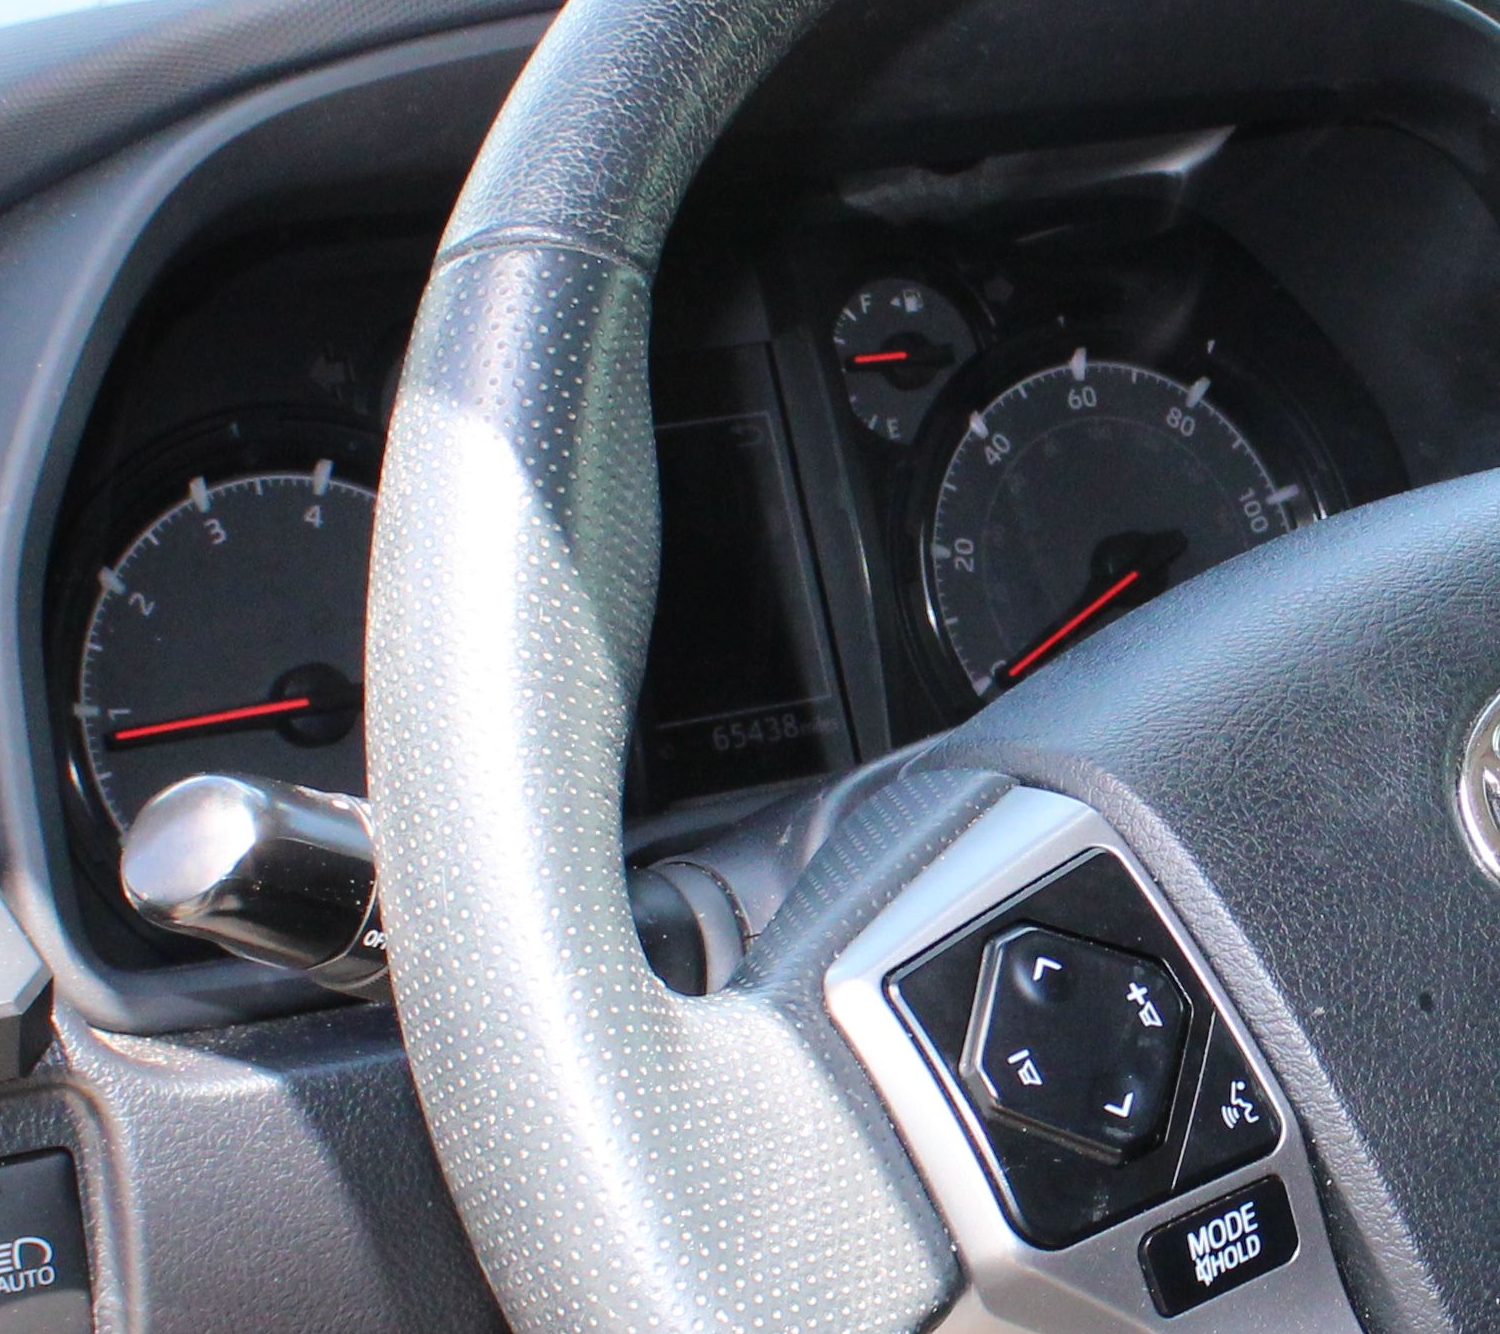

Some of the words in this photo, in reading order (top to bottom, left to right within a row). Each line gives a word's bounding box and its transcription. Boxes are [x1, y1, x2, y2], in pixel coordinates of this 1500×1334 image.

[860, 293, 871, 314] F
[1068, 385, 1097, 410] 60
[886, 419, 901, 440] E
[1165, 406, 1196, 437] 80
[983, 433, 1011, 465] 40
[304, 504, 323, 530] 4
[1239, 487, 1269, 534] 100
[202, 518, 228, 546] 3
[955, 537, 975, 573] 20
[128, 590, 156, 618] 2
[712, 714, 799, 752] 65438
[1187, 1202, 1260, 1259] MODE
[1209, 1233, 1263, 1281] HOLD
